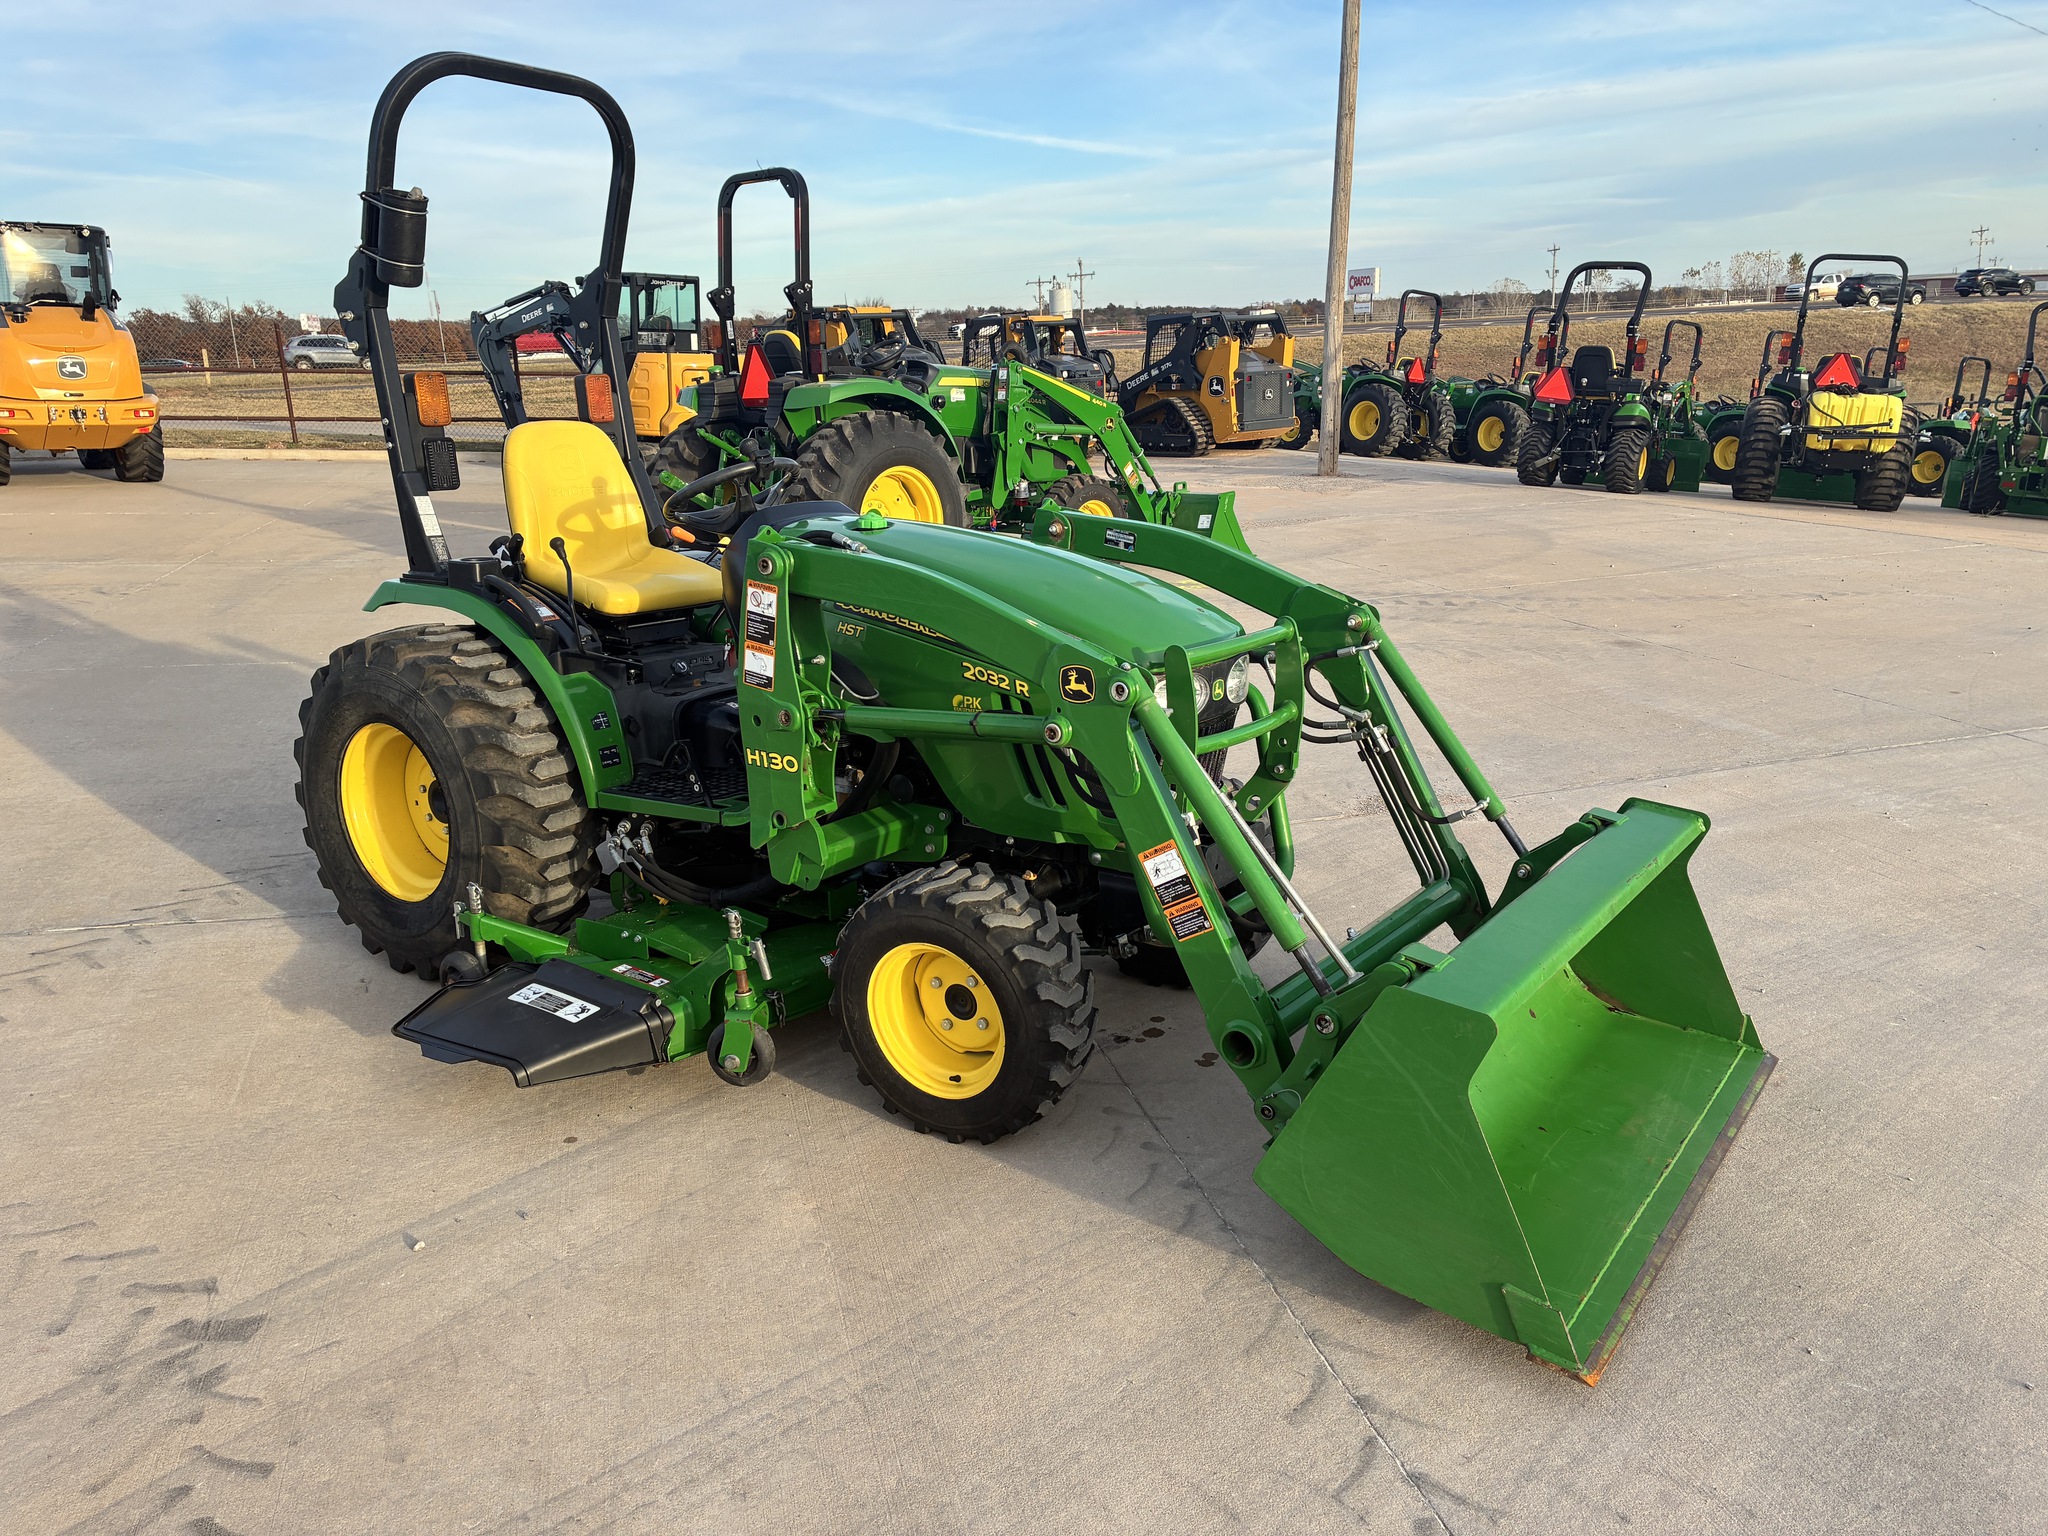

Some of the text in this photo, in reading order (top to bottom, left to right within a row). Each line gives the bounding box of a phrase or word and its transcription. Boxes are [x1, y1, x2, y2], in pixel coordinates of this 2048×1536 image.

[521, 307, 543, 323] DEERE
[1126, 372, 1150, 390] DEERE
[836, 621, 864, 638] HST
[750, 644, 774, 656] WARNING
[962, 661, 1031, 698] 2032 R
[746, 748, 799, 773] H130
[1149, 844, 1172, 857] WARNING
[1175, 901, 1199, 914] WARNING
